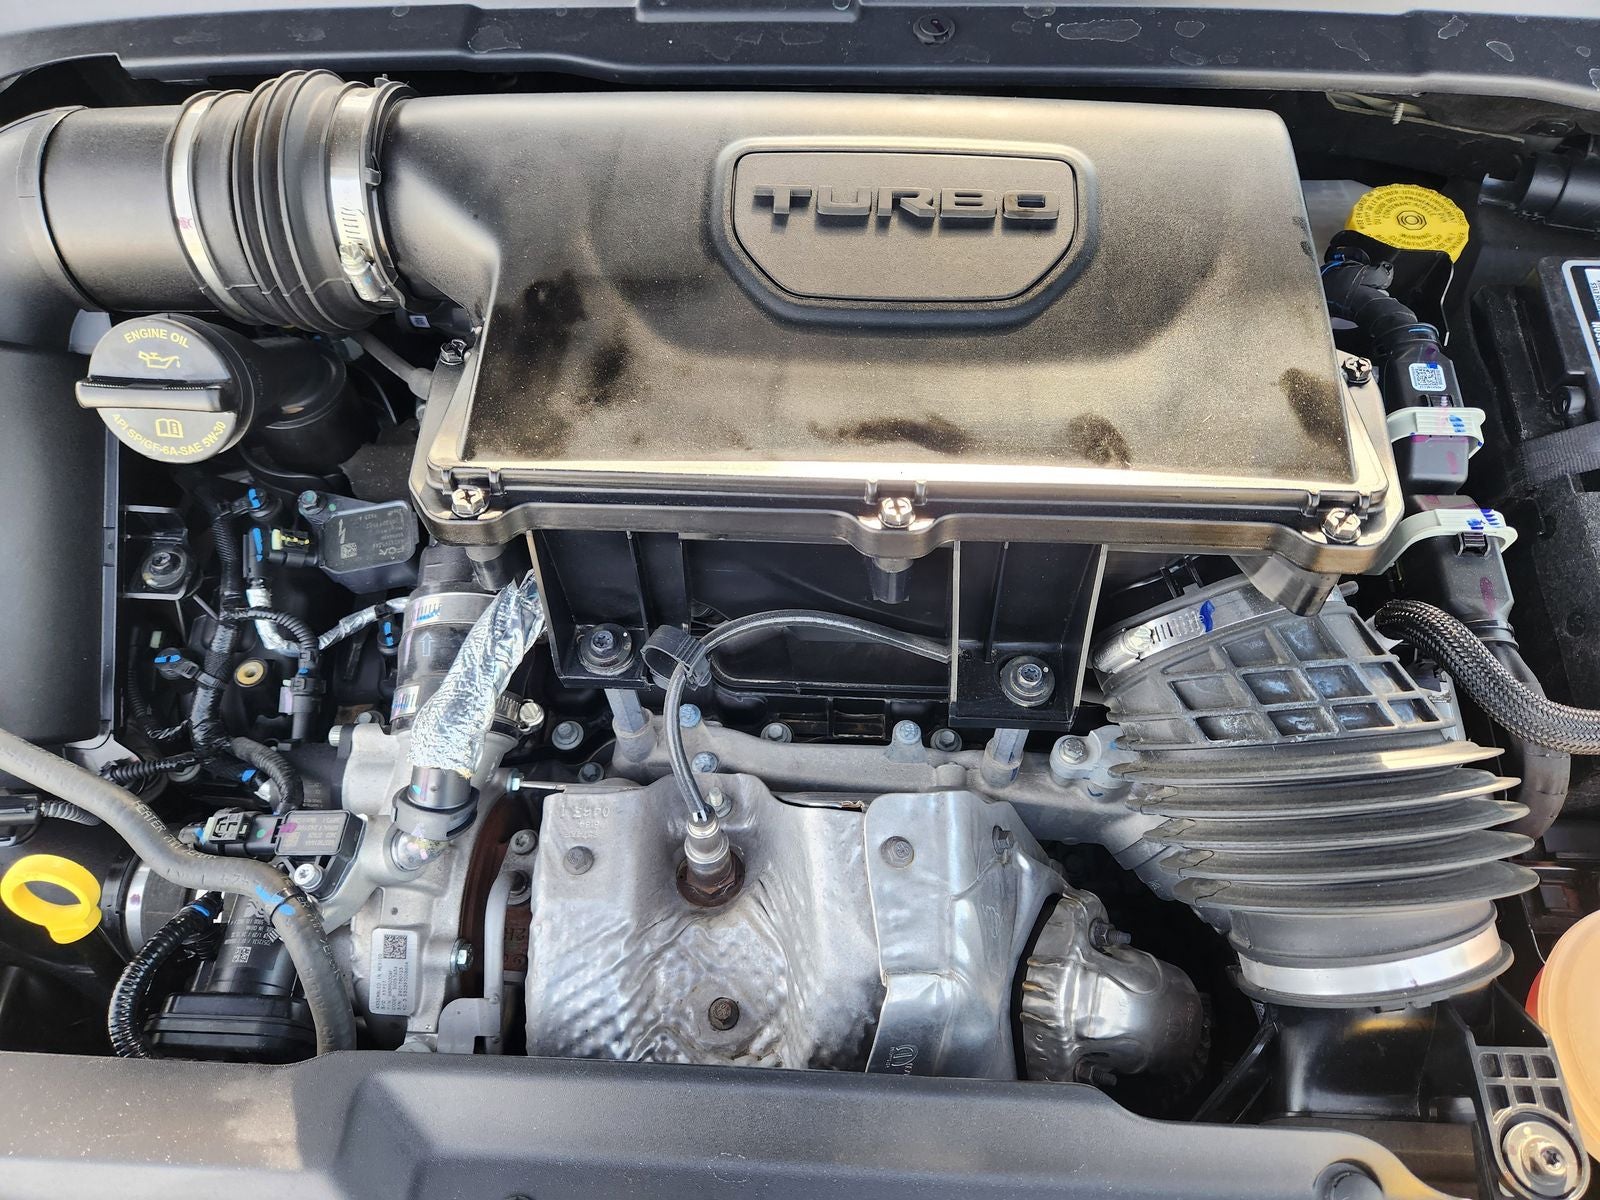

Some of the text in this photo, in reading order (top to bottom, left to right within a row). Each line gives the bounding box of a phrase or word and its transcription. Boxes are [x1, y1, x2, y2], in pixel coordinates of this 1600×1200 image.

[753, 184, 1060, 219] TURBO
[124, 328, 190, 348] ENGINE OIL
[112, 413, 127, 432] API
[203, 420, 227, 449] 5W-30
